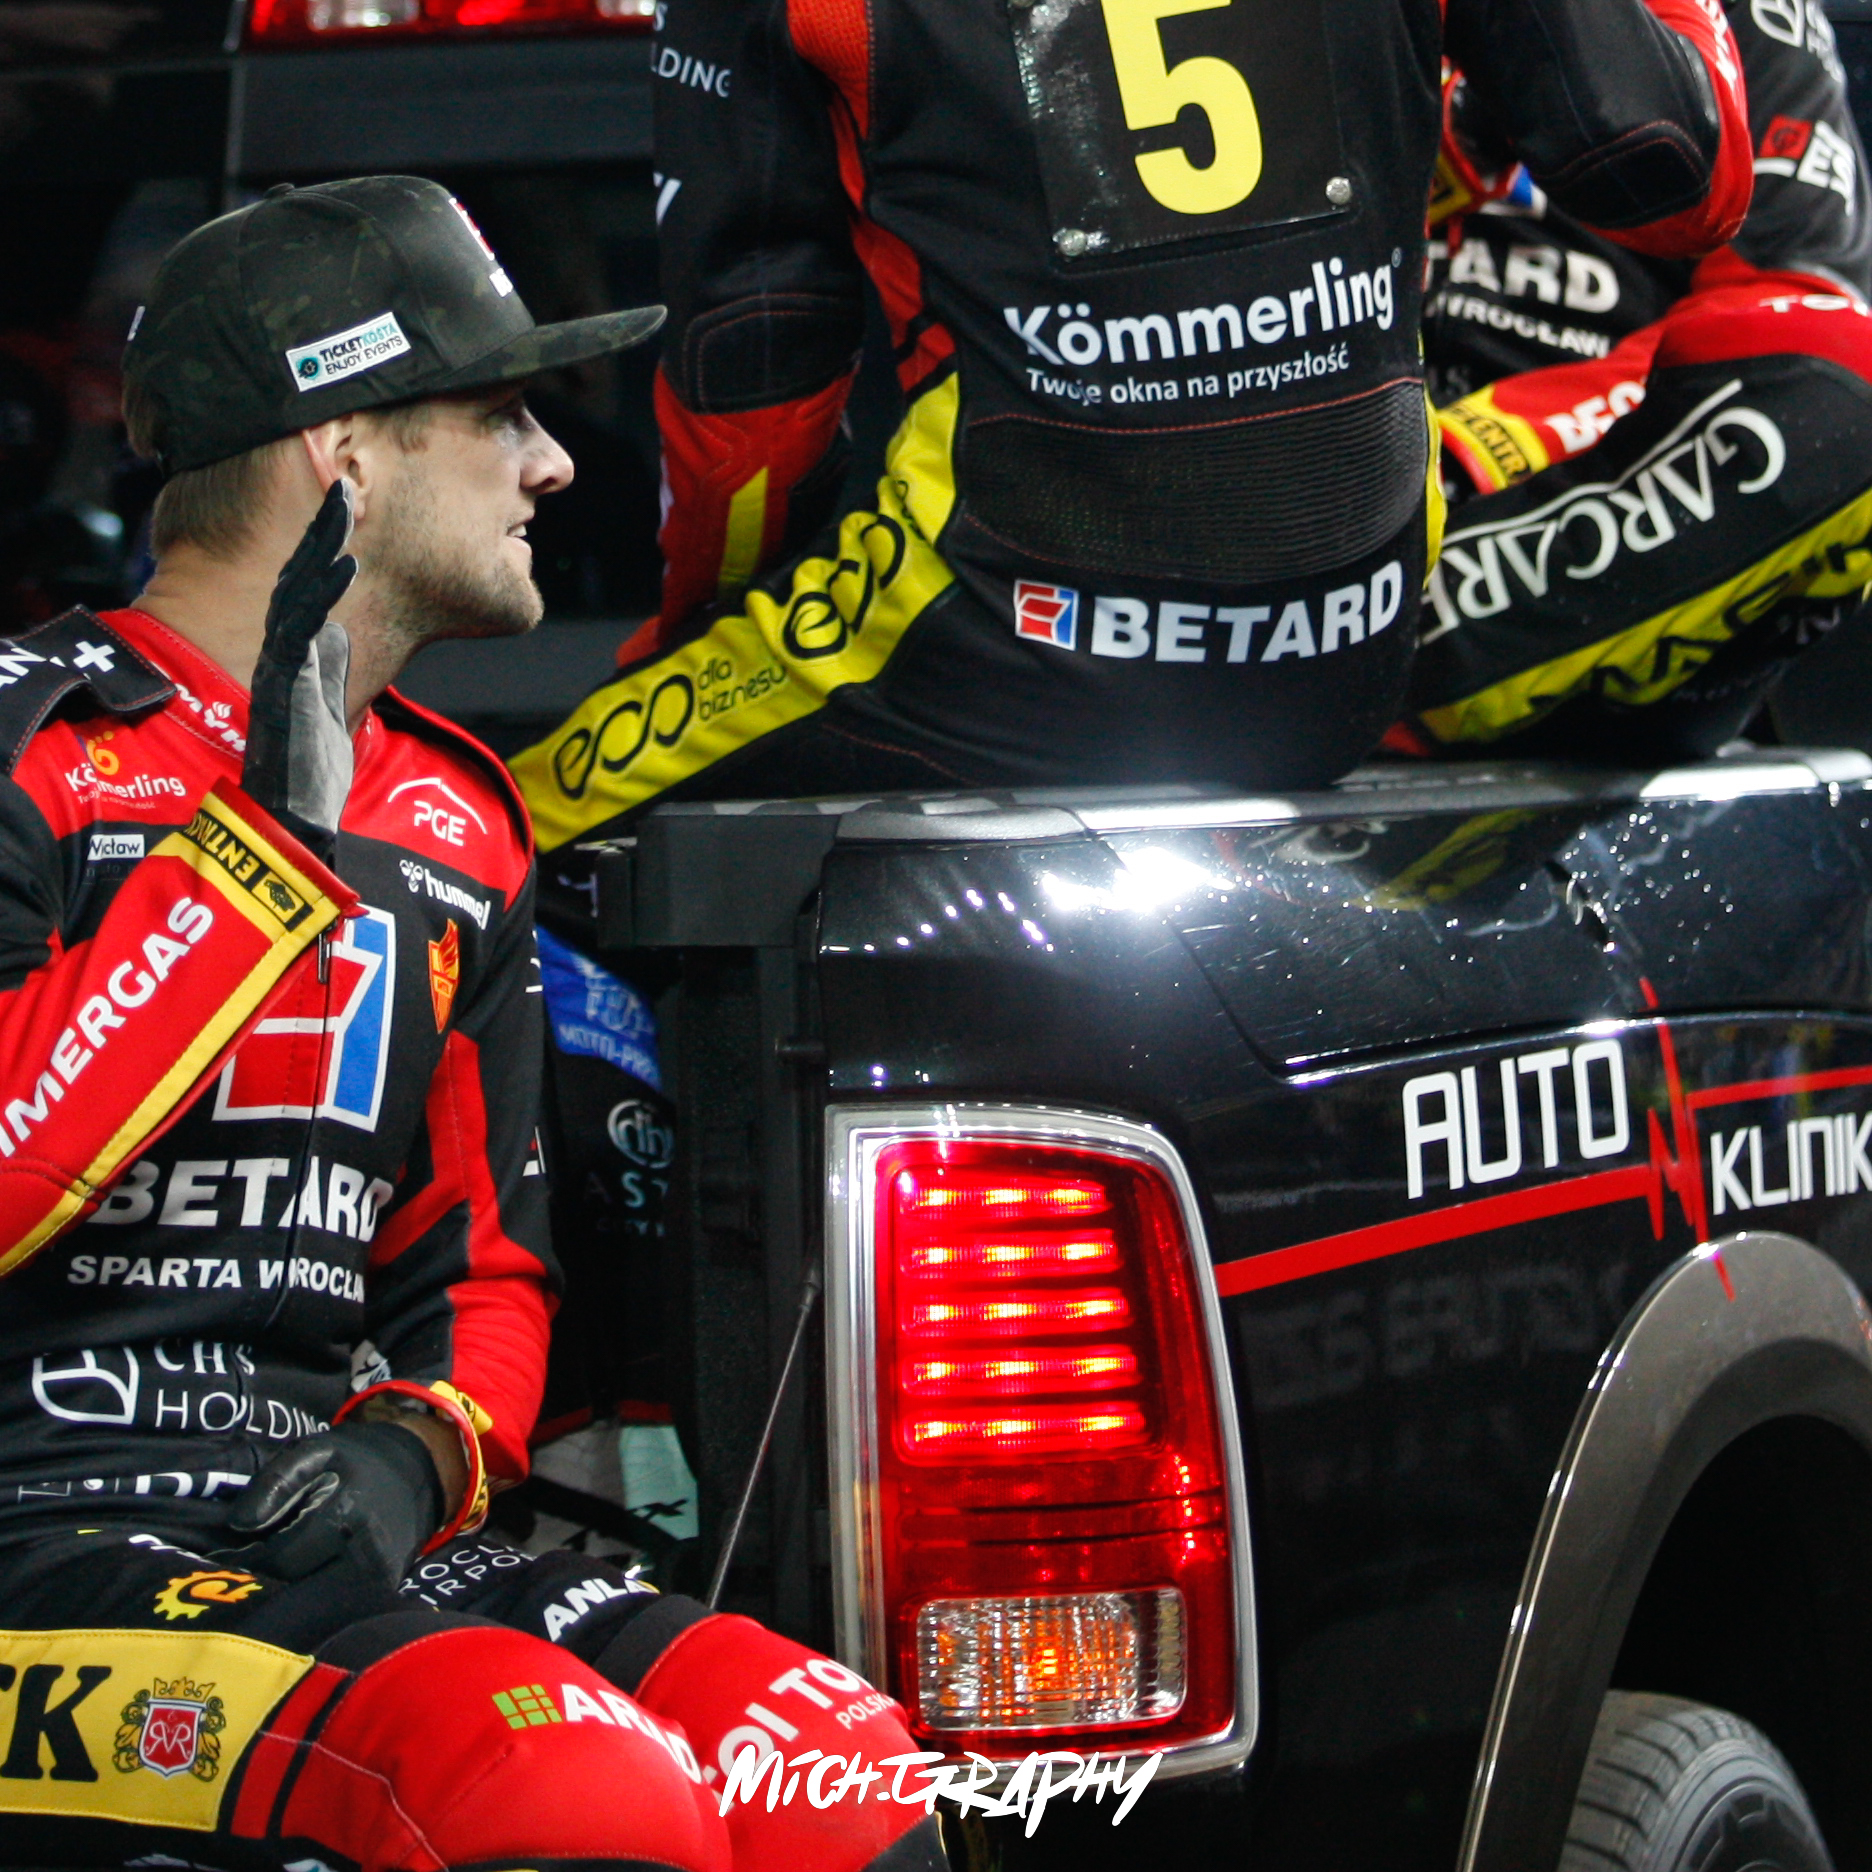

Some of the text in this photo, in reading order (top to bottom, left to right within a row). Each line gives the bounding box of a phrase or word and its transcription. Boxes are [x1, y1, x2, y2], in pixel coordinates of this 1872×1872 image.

[1004, 256, 1395, 369] Kömmerling
[325, 335, 403, 375] ENJOY EVENTS
[1026, 341, 1351, 406] Twoje okna na przyszłość
[1091, 561, 1404, 663] BETARD
[552, 673, 695, 801] eco
[413, 800, 467, 847] PGE
[424, 868, 492, 930] hummel
[1401, 1038, 1629, 1199] AUTO
[66, 1255, 243, 1288] SPARTA
